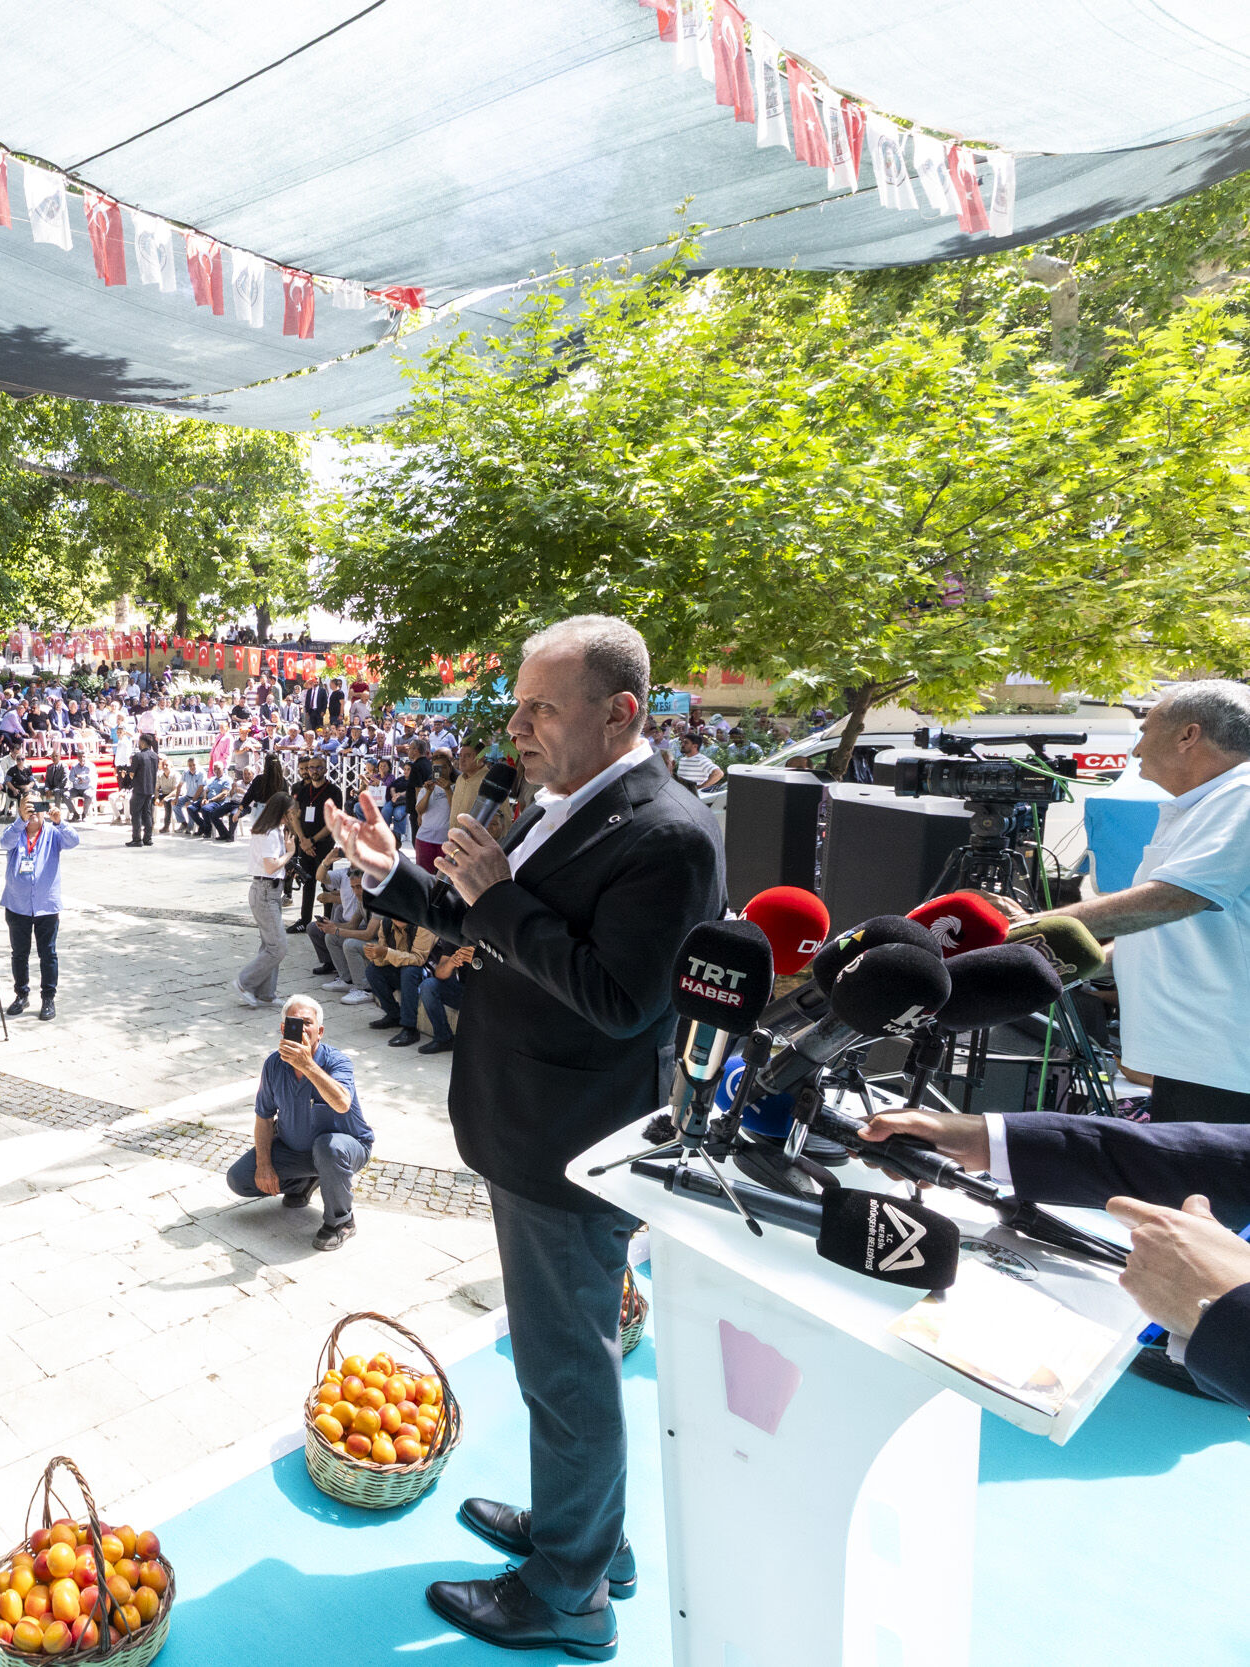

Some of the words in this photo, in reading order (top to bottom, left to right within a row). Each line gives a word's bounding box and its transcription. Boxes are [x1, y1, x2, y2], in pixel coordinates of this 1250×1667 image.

[425, 702, 452, 713] MUT
[688, 955, 747, 990] TRT
[681, 977, 742, 1006] HABER
[867, 1198, 880, 1236] BÜYÜKŞEHİR
[877, 1223, 886, 1250] MERSİN
[864, 1237, 876, 1272] BELEDİYESİ
